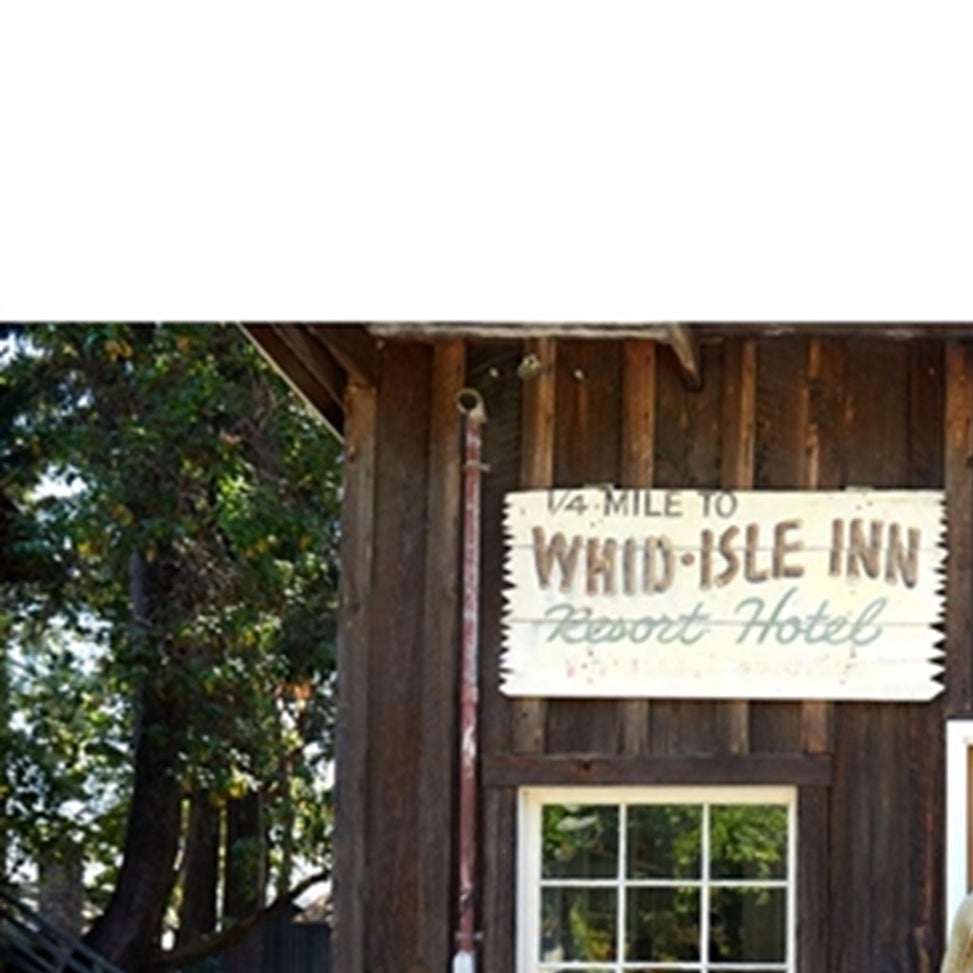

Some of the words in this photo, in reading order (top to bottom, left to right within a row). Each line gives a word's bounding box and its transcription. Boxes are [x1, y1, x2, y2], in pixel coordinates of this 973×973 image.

[603, 487, 683, 518] MILE
[698, 489, 738, 519] TO
[829, 518, 921, 589] INN
[544, 602, 712, 645] Resort
[735, 586, 887, 646] Hotel
